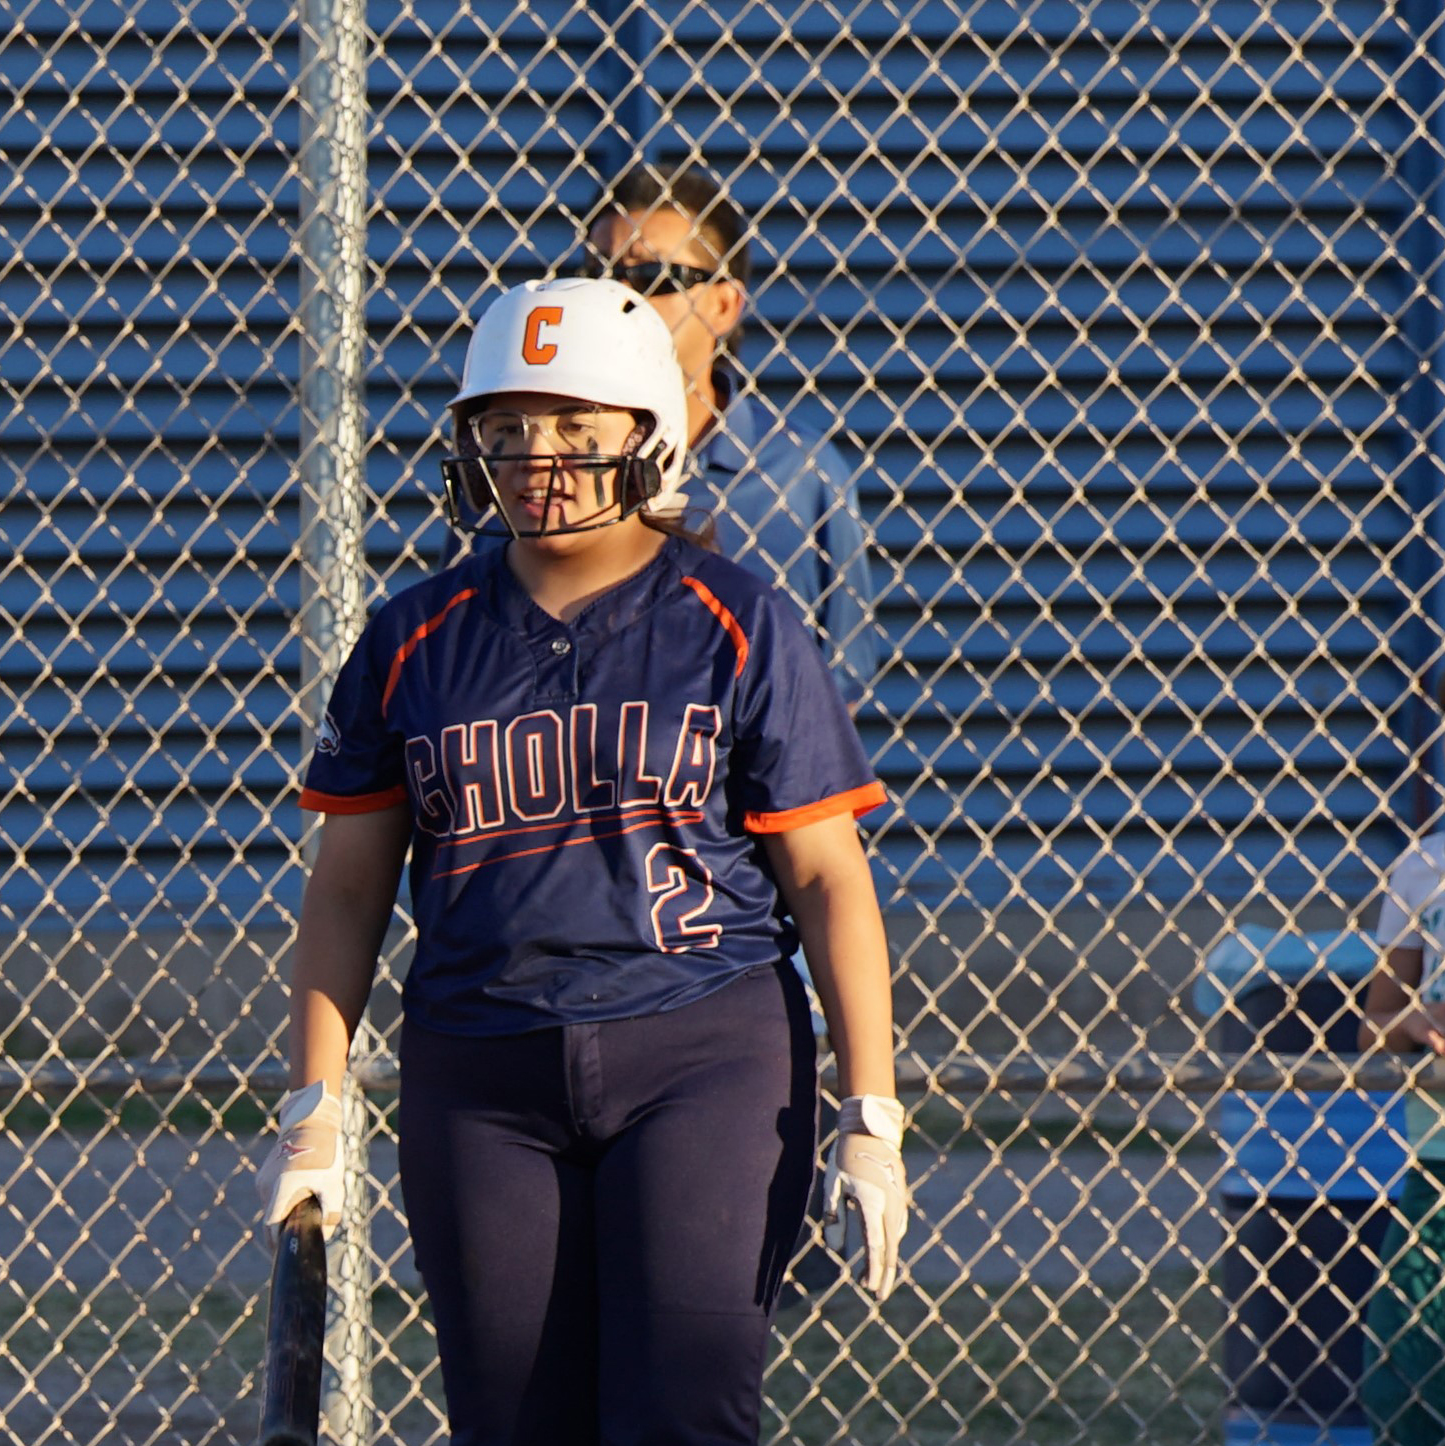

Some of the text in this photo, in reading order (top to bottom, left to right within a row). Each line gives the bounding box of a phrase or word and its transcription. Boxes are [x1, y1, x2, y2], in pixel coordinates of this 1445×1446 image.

[522, 306, 564, 365] C
[405, 701, 722, 838] CHOLLA
[645, 843, 722, 953] 2
